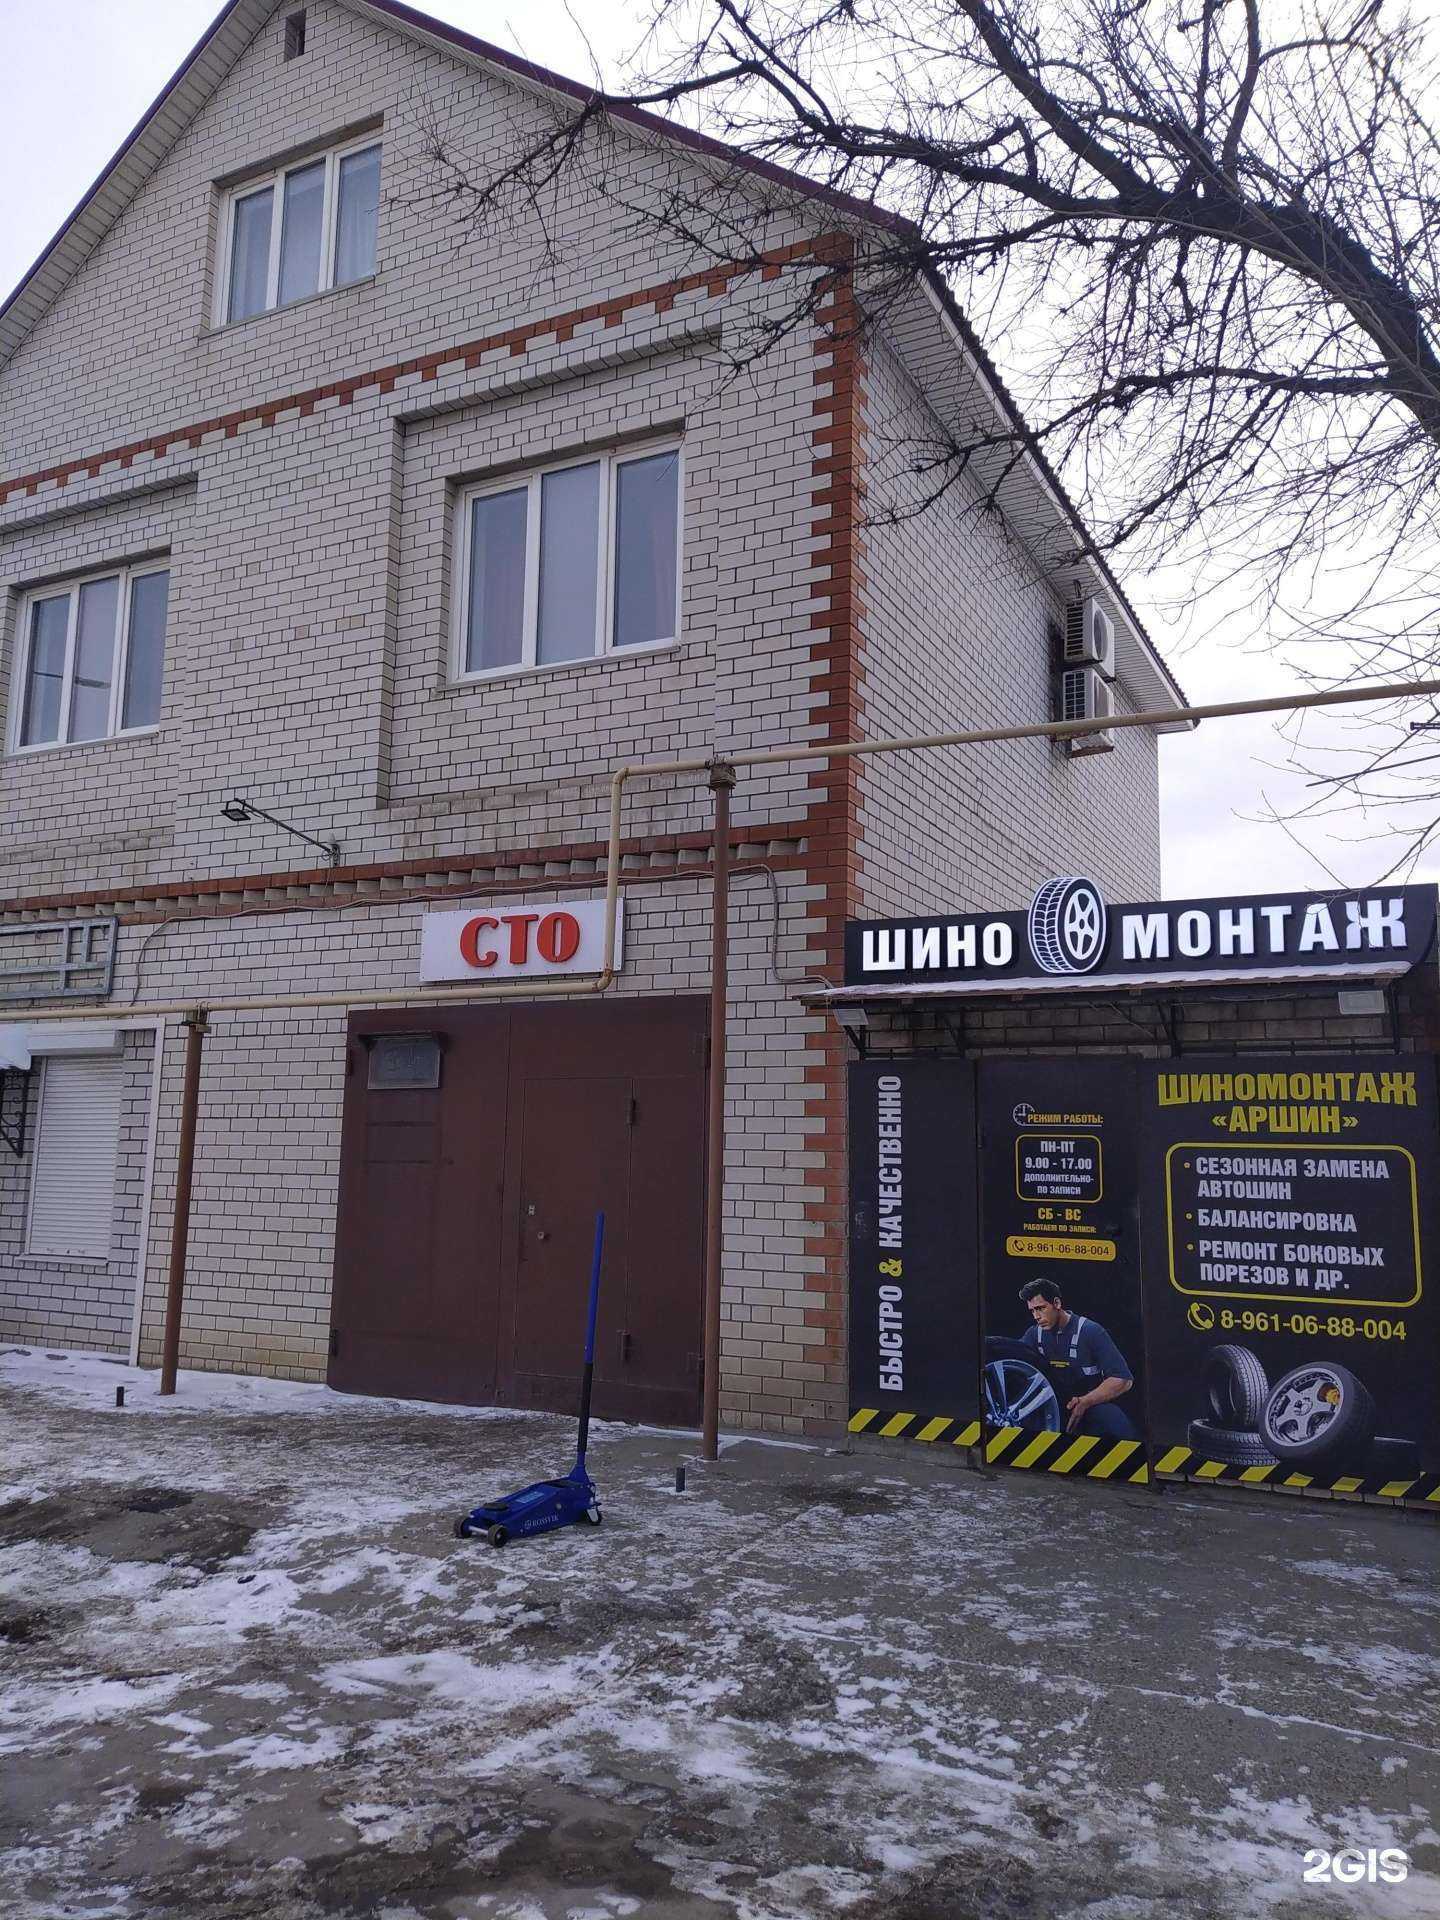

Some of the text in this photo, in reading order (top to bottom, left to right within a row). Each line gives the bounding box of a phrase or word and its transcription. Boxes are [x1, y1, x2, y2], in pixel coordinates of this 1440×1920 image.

[460, 912, 580, 967] СТО
[862, 897, 1408, 971] ШИНО МОНТАЖ
[1158, 1072, 1418, 1106] ШИНОМОНТАЖ
[1027, 1114, 1104, 1124] РЕЖИМ РАБОТЫ:
[1212, 1105, 1359, 1133] «АРШИН»
[1040, 1141, 1075, 1153] ПН-ПТ
[1025, 1157, 1050, 1169] 9.00
[1061, 1158, 1093, 1170] 17.00
[1195, 1157, 1390, 1179] СЕЗОННАЯ ЗАМЕНА
[1037, 1185, 1081, 1195] ПО ЗАПИСИ
[1197, 1180, 1292, 1200] АВТОШИН
[1037, 1207, 1054, 1220] СБ
[1065, 1208, 1082, 1221] ВС
[1197, 1208, 1358, 1233] БАЛАНСИРОВКА
[878, 1075, 903, 1391] БЫСТРО & КАЧЕСТВЕННО
[1027, 1242, 1110, 1256] 8-961-06-88-004
[1199, 1239, 1385, 1267] РЕМОНТ БОКОВЫХ
[1200, 1263, 1350, 1292] ПОРЕЗОВ И ДР.
[1220, 1309, 1407, 1341] 8-961-06-88-004
